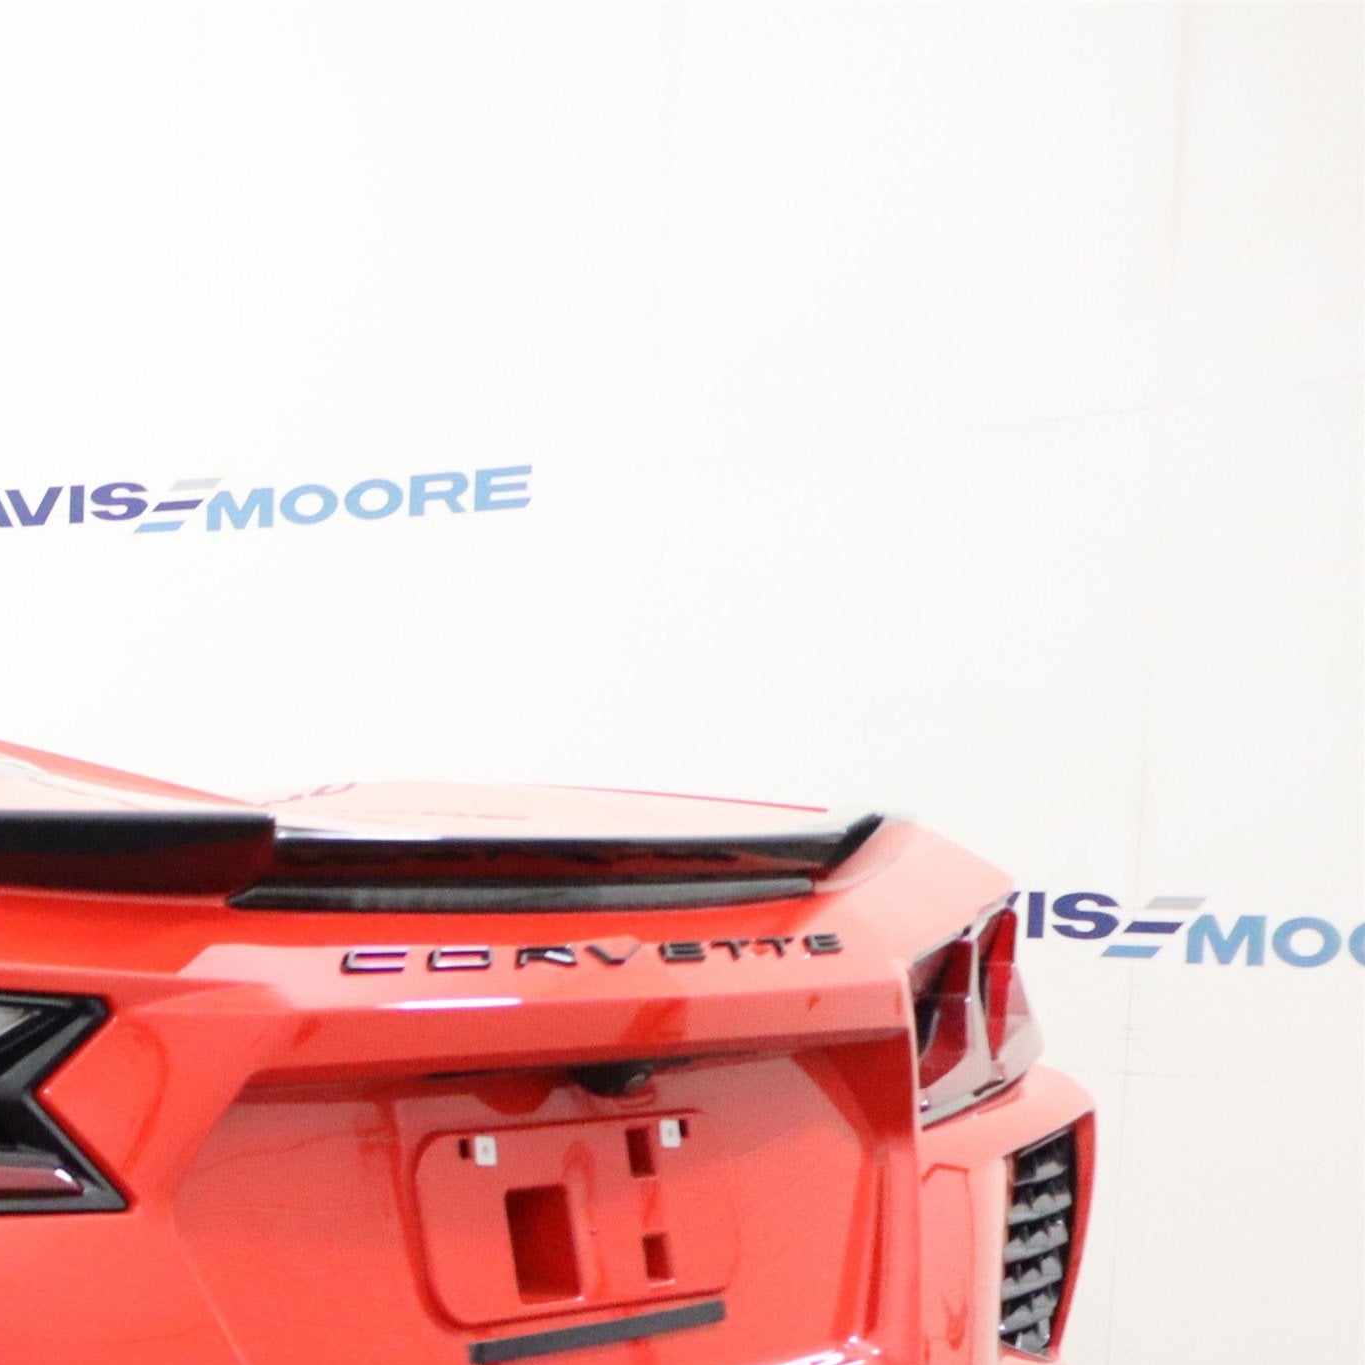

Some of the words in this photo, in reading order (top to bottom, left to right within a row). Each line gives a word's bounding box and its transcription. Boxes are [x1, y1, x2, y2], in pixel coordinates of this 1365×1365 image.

[205, 464, 533, 532] MOORE
[340, 932, 844, 973] CORVETTE
[1007, 891, 1121, 940] IS
[1185, 914, 1365, 968] MO
